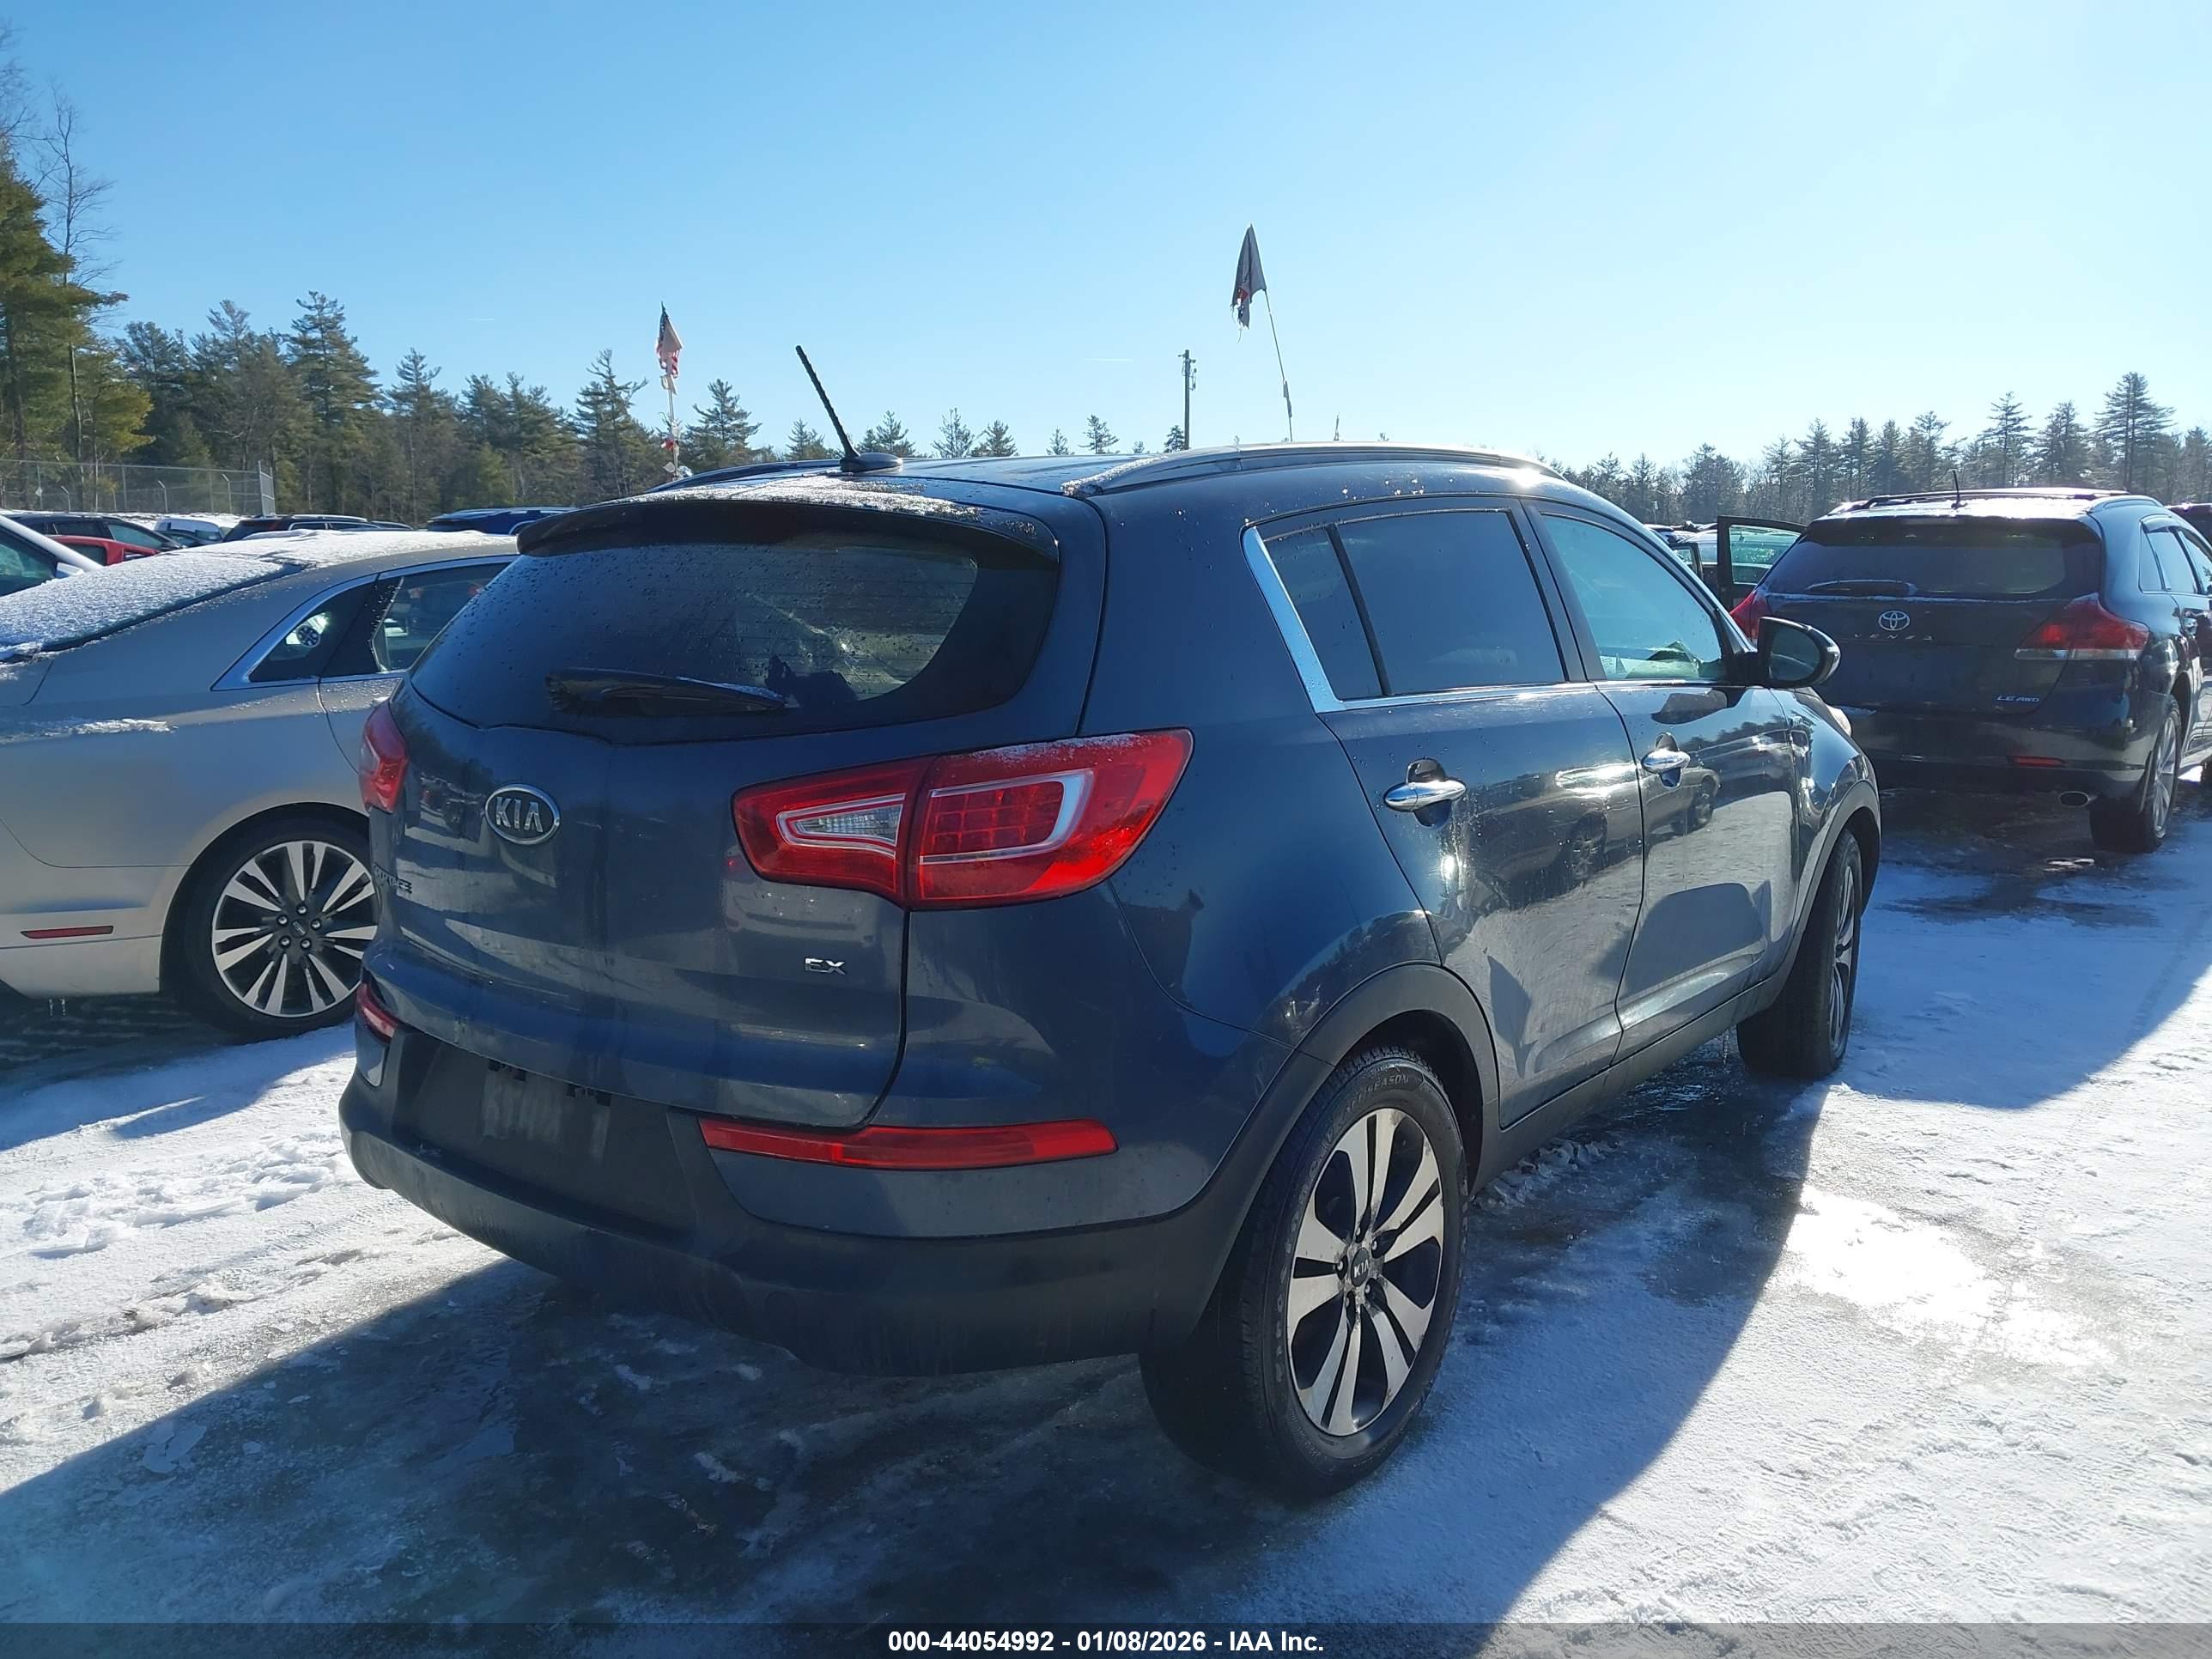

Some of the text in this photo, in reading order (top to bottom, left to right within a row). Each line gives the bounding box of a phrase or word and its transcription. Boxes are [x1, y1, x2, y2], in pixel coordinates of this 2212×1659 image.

[495, 796, 544, 833] KIA
[805, 957, 846, 975] EX
[1353, 1258, 1369, 1279] KIA
